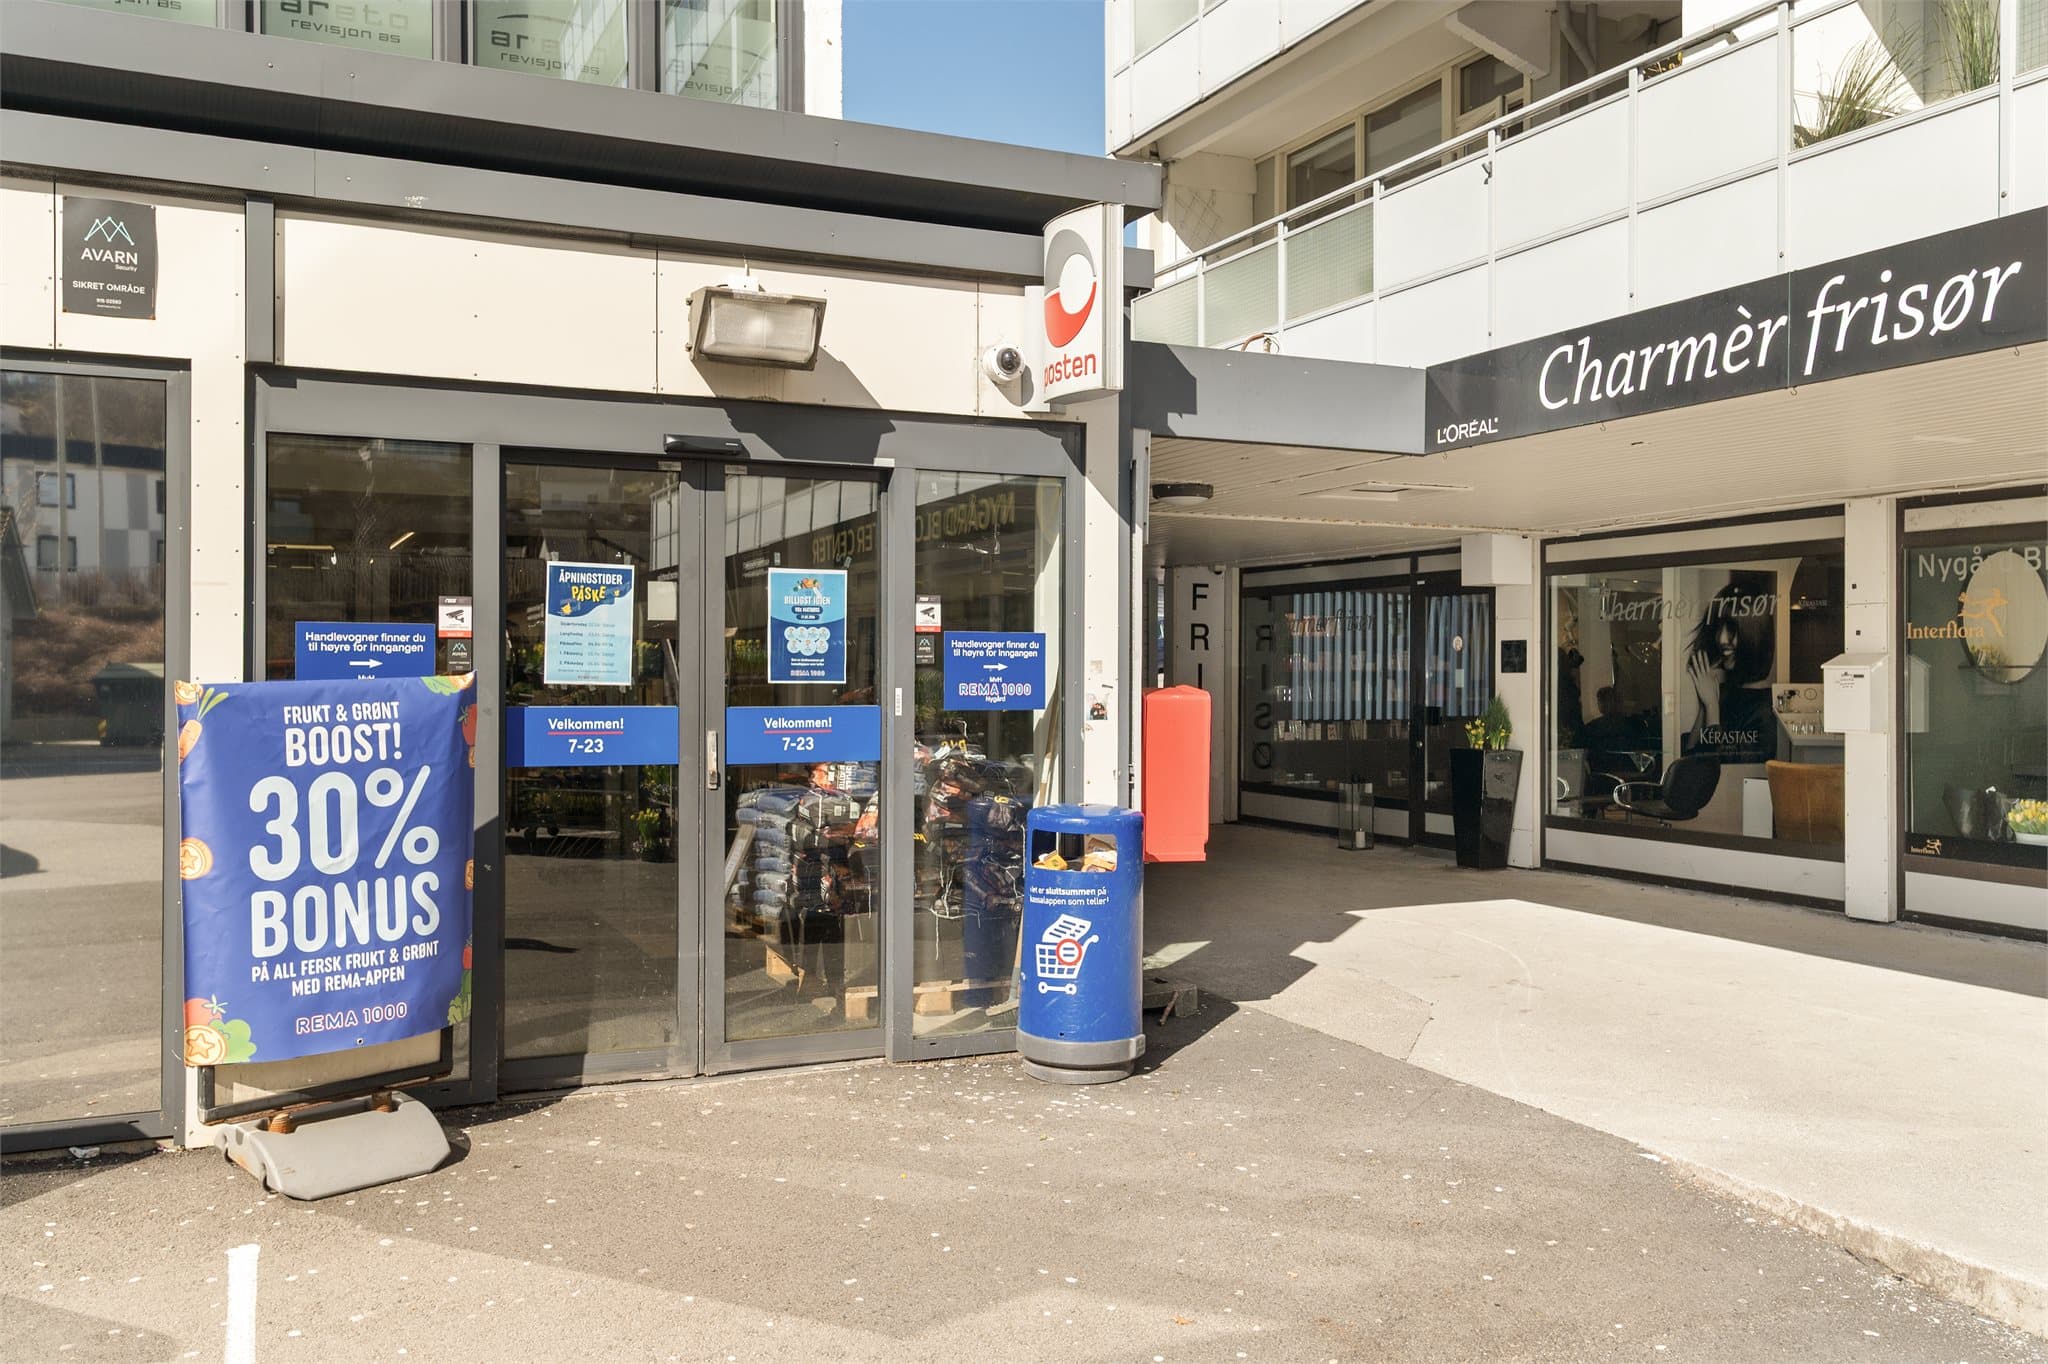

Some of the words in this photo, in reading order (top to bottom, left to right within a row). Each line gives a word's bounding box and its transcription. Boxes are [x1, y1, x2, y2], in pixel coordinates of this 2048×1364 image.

[290, 19, 372, 39] revisjon
[378, 32, 401, 44] as
[500, 51, 577, 75] revisjon
[684, 80, 745, 97] evisjon
[80, 247, 138, 265] AVARN
[115, 264, 138, 272] Security
[72, 280, 105, 290] SIKRET
[106, 283, 145, 294] OMRÅDE
[1538, 304, 1788, 411] Charmèr
[1803, 260, 2024, 378] frisør
[1043, 353, 1097, 394] posten
[1918, 545, 2013, 583] Nygå
[559, 568, 623, 585] ÅPNINGSTIDER
[571, 585, 606, 602] PÅSKE
[784, 595, 811, 605] BILLIGST
[1703, 586, 1779, 626] frisør
[305, 631, 378, 644] Handlevogner
[381, 632, 410, 642] finner
[415, 632, 426, 643] du
[1907, 620, 1984, 639] Interflora
[308, 642, 318, 651] til
[320, 642, 350, 654] høyre
[353, 642, 367, 652] for
[951, 640, 1004, 650] Handlevogner
[1006, 640, 1027, 649] finner
[1029, 641, 1040, 649] du
[963, 649, 984, 658] høyre
[985, 649, 996, 657] for
[959, 683, 999, 696] REMA
[1002, 683, 1032, 696] 1000
[985, 695, 1006, 703] Nygård
[284, 705, 330, 724] FRUKT
[336, 704, 348, 722] &
[352, 701, 400, 721] GRØNT
[547, 717, 624, 730] Velkommen!
[763, 716, 832, 729] Velkommen!
[285, 722, 403, 767] BOOST!
[782, 736, 814, 751] 7-23
[1700, 727, 1759, 745] KÉRASTASE
[568, 738, 604, 754] 7-23
[249, 764, 440, 882] 30%
[1045, 887, 1096, 896] sluttsummen
[1097, 886, 1107, 897] på
[1067, 898, 1085, 906] som
[251, 871, 440, 959] BONUS
[252, 961, 270, 982] PÅ
[274, 962, 297, 980] ALL
[301, 956, 342, 976] FERSK
[345, 949, 385, 970] FRUKT
[390, 948, 399, 963] &
[402, 940, 439, 961] GRØNT
[292, 978, 320, 997] MED
[325, 965, 406, 992] REMA-APPEN
[296, 1009, 358, 1035] REMA
[363, 1002, 408, 1024] 1000
